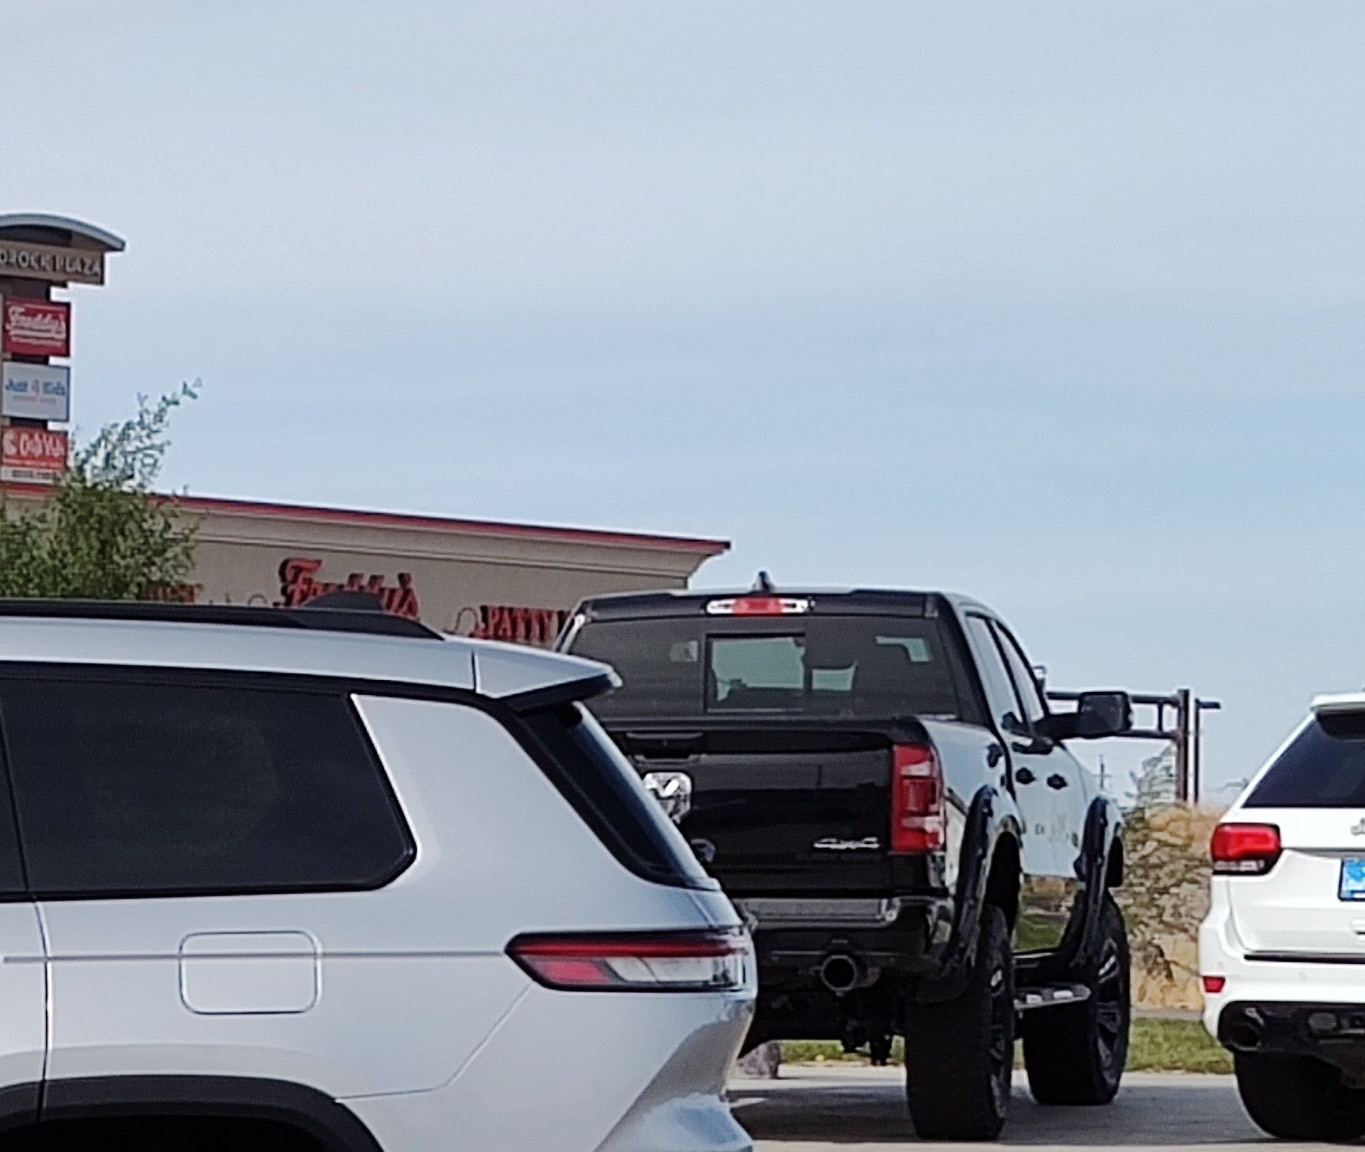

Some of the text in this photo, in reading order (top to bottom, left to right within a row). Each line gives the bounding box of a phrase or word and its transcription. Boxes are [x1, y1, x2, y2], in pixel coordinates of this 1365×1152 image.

[54, 254, 101, 277] PLAZA
[42, 381, 66, 396] Kids
[278, 558, 420, 621] Fry's
[480, 605, 557, 643] PATTY
